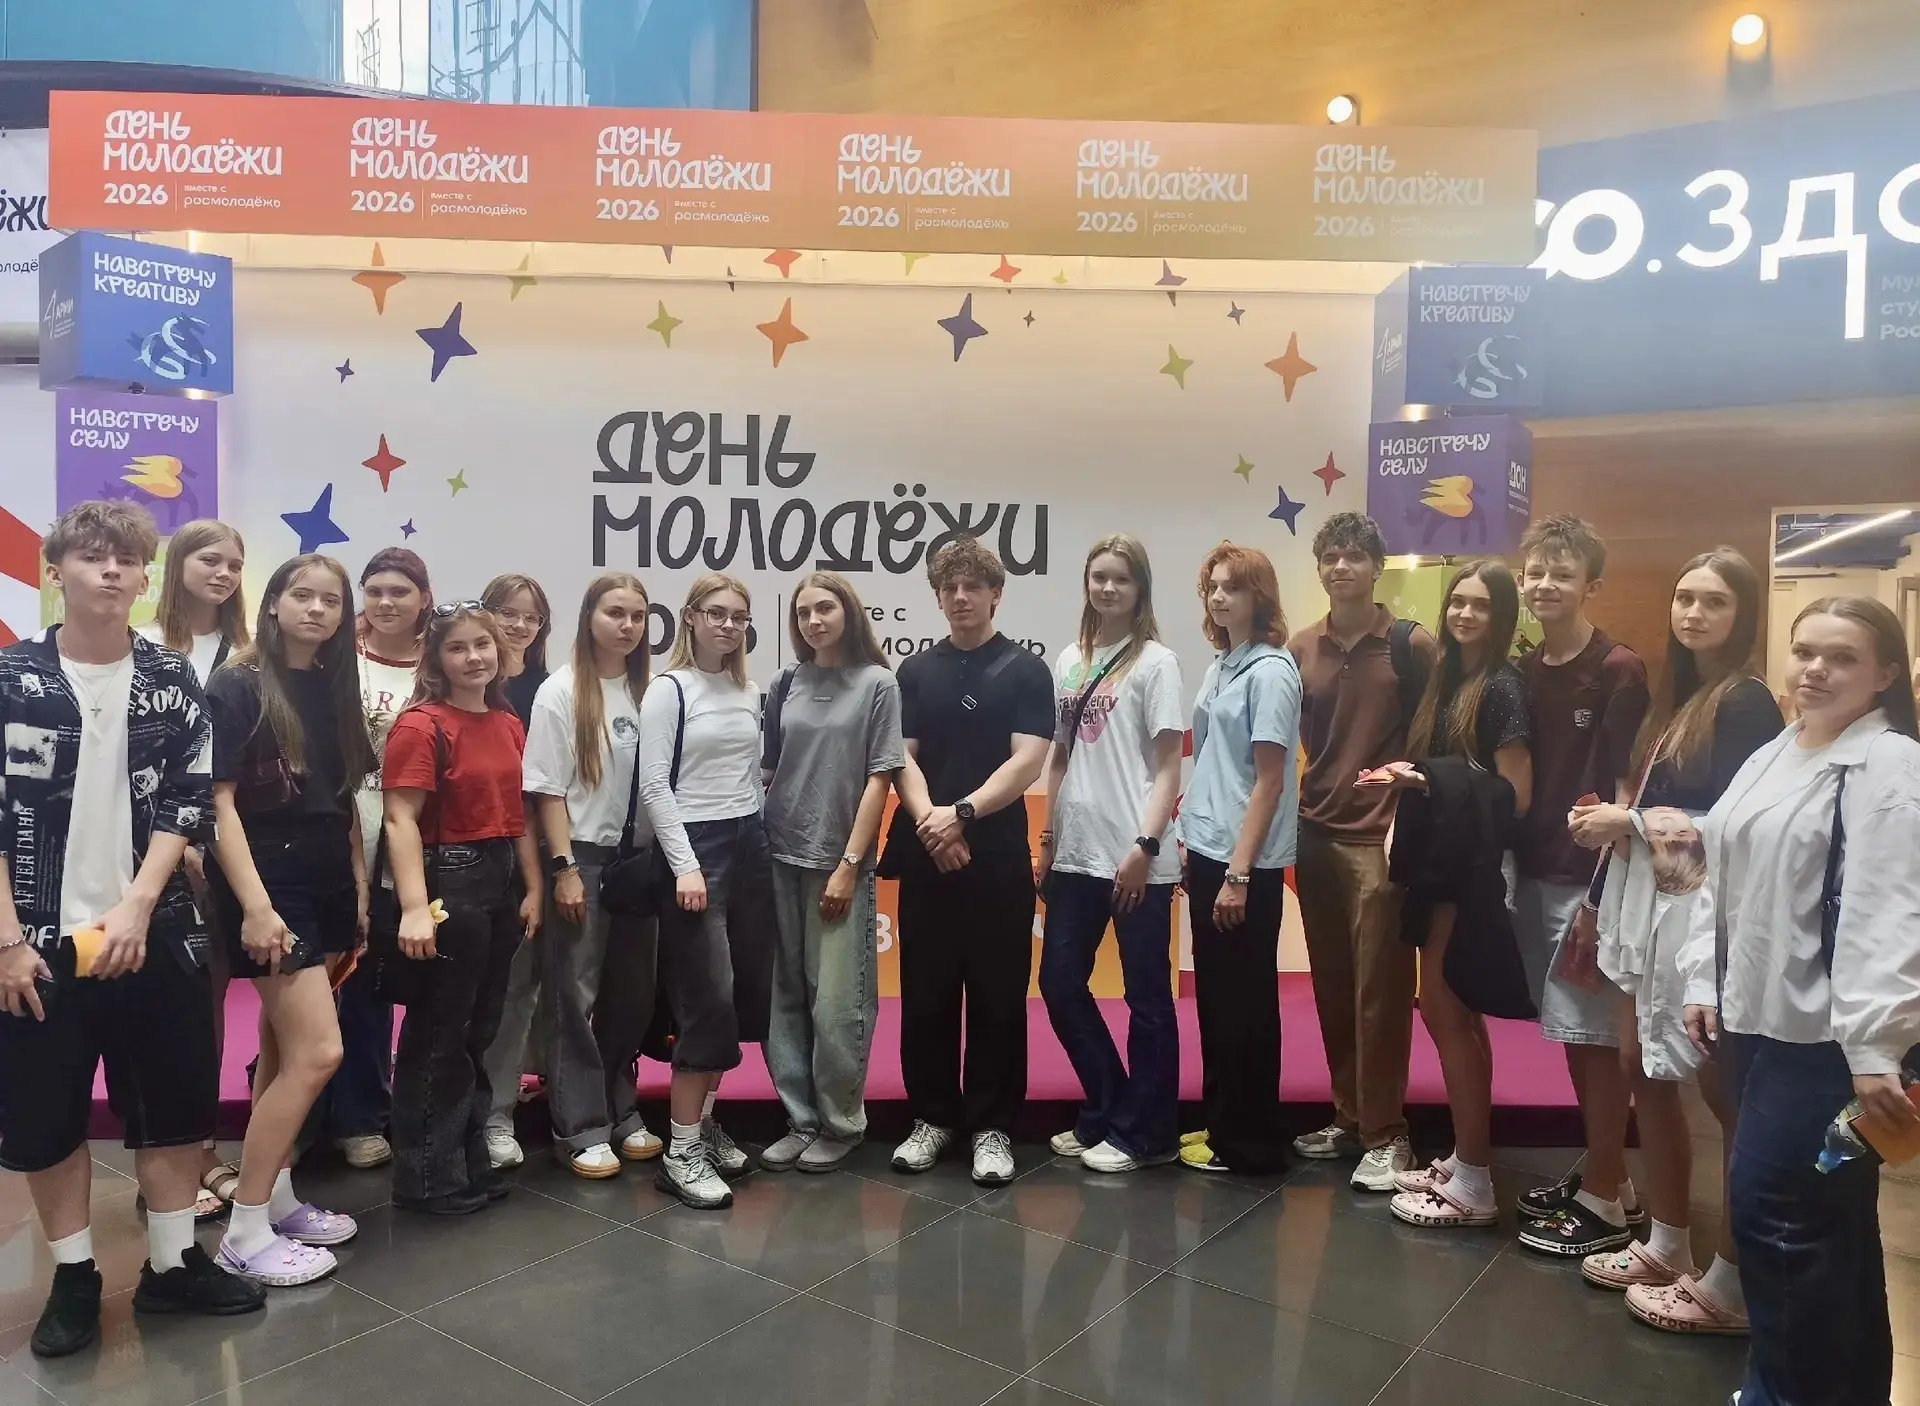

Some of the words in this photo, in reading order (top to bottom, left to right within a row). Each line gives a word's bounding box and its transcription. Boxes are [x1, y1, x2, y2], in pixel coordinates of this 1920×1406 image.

[104, 184, 168, 206] 2026
[184, 184, 217, 193] вместе
[431, 192, 464, 200] вместе
[184, 195, 281, 209] росмолодёжь
[351, 191, 414, 213] 2026
[431, 202, 527, 216] росмолодёжь
[596, 199, 659, 220] 2026
[674, 209, 770, 224] росмолодёжь
[838, 205, 900, 227] 2026
[1077, 211, 1138, 233] 2026
[1314, 216, 1374, 237] 2026
